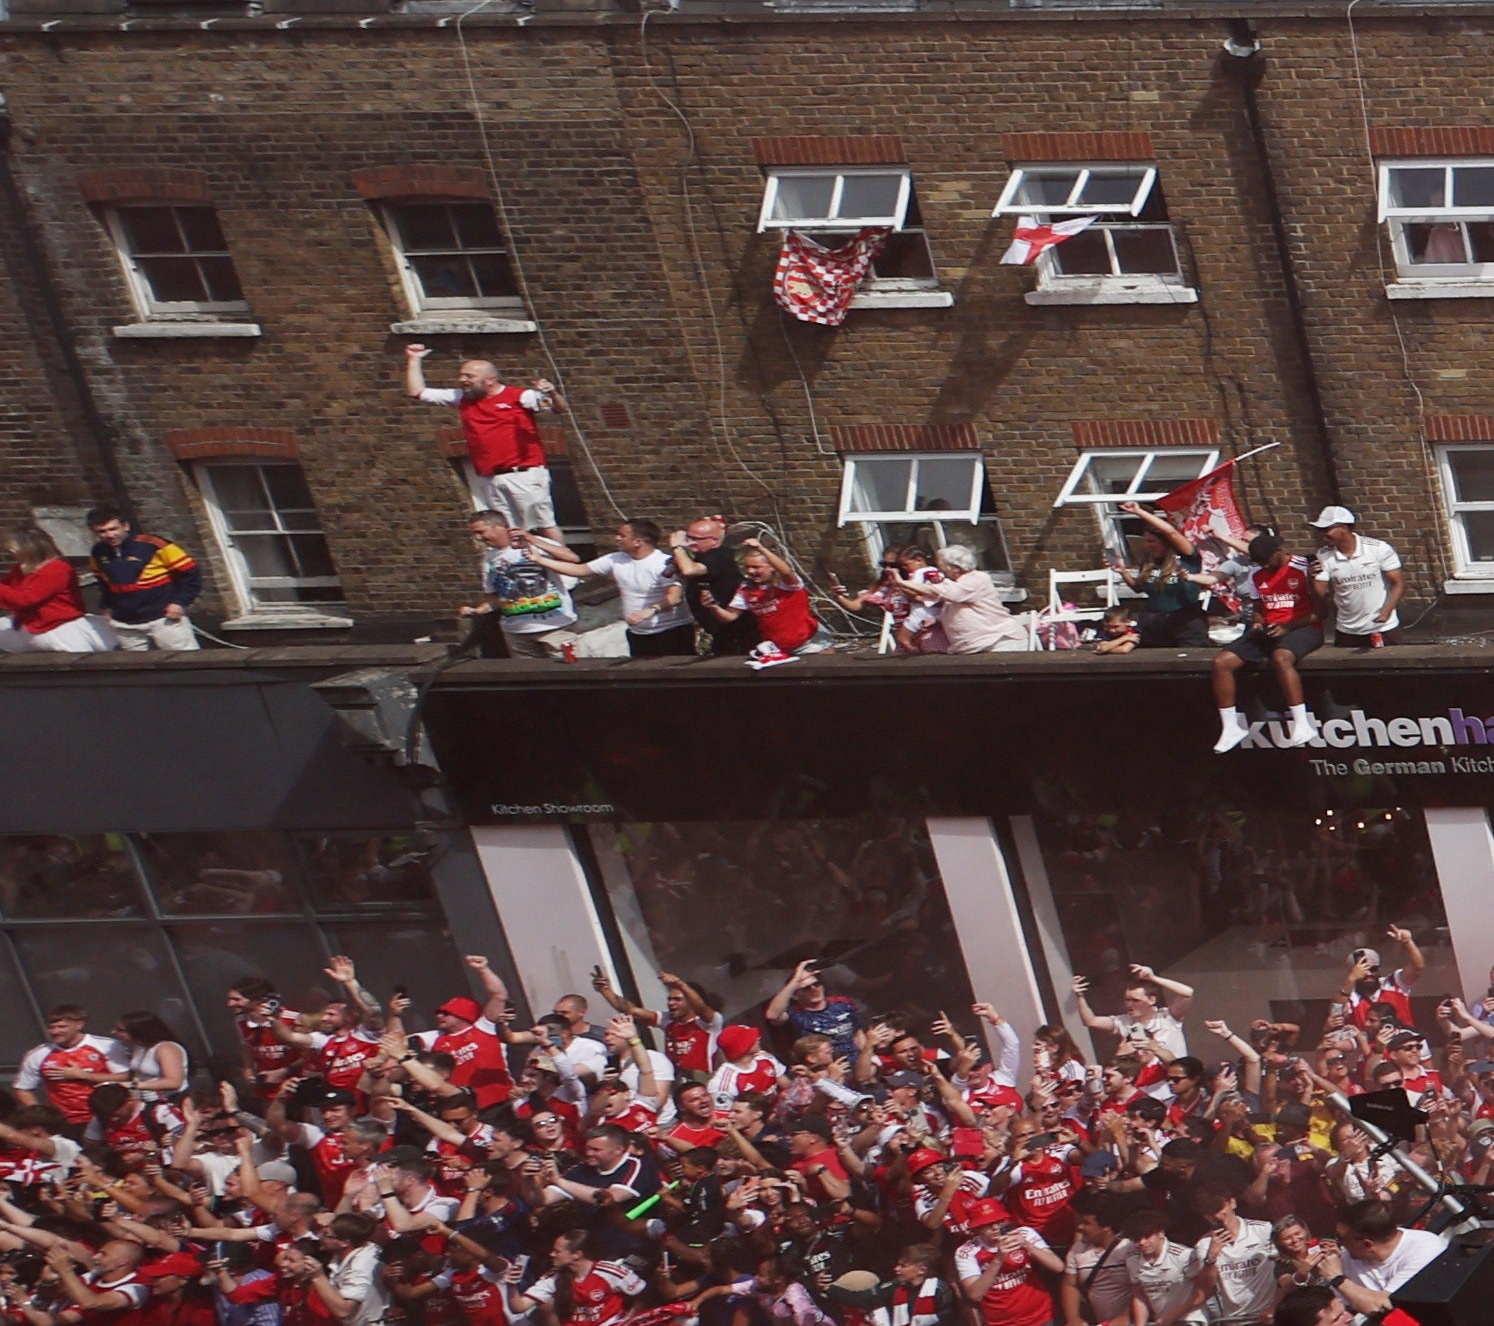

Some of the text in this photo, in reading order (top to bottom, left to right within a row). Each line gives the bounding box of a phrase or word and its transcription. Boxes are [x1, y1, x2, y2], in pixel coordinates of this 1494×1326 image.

[1309, 757, 1349, 775] The
[1354, 757, 1446, 776] German
[492, 802, 614, 816] Kitchen Showroom
[1025, 1179, 1071, 1200] Emirates
